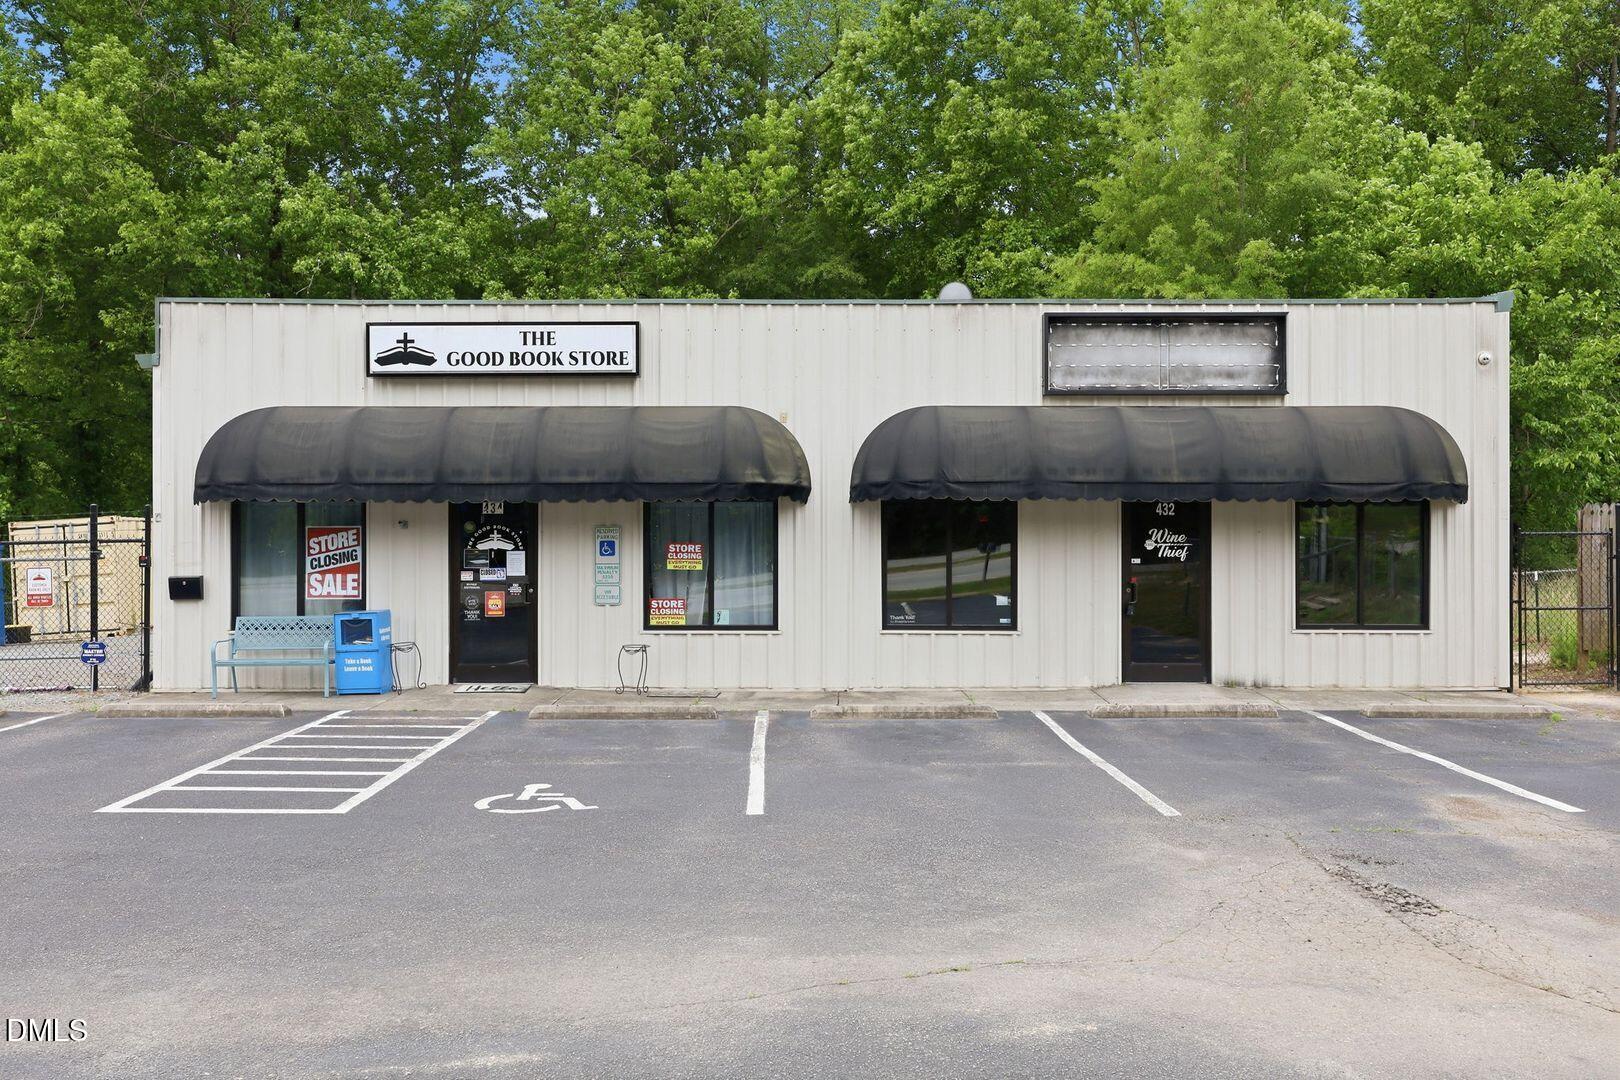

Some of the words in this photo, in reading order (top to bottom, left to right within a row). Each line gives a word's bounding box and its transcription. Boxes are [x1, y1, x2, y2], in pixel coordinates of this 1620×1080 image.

[519, 330, 557, 346] THE
[446, 351, 504, 367] GOOD
[509, 351, 565, 366] BOOK
[568, 350, 629, 366] STORE
[483, 501, 503, 514] 434
[1155, 502, 1175, 516] 432
[474, 525, 491, 537] GOOD
[492, 524, 510, 533] BOOK
[1148, 528, 1188, 543] Wine
[309, 529, 358, 555] STORE
[668, 544, 702, 552] STORE
[309, 549, 358, 570] CLOSING
[1157, 544, 1189, 562] Thief
[309, 573, 359, 596] SALE
[651, 600, 684, 608] STORE
